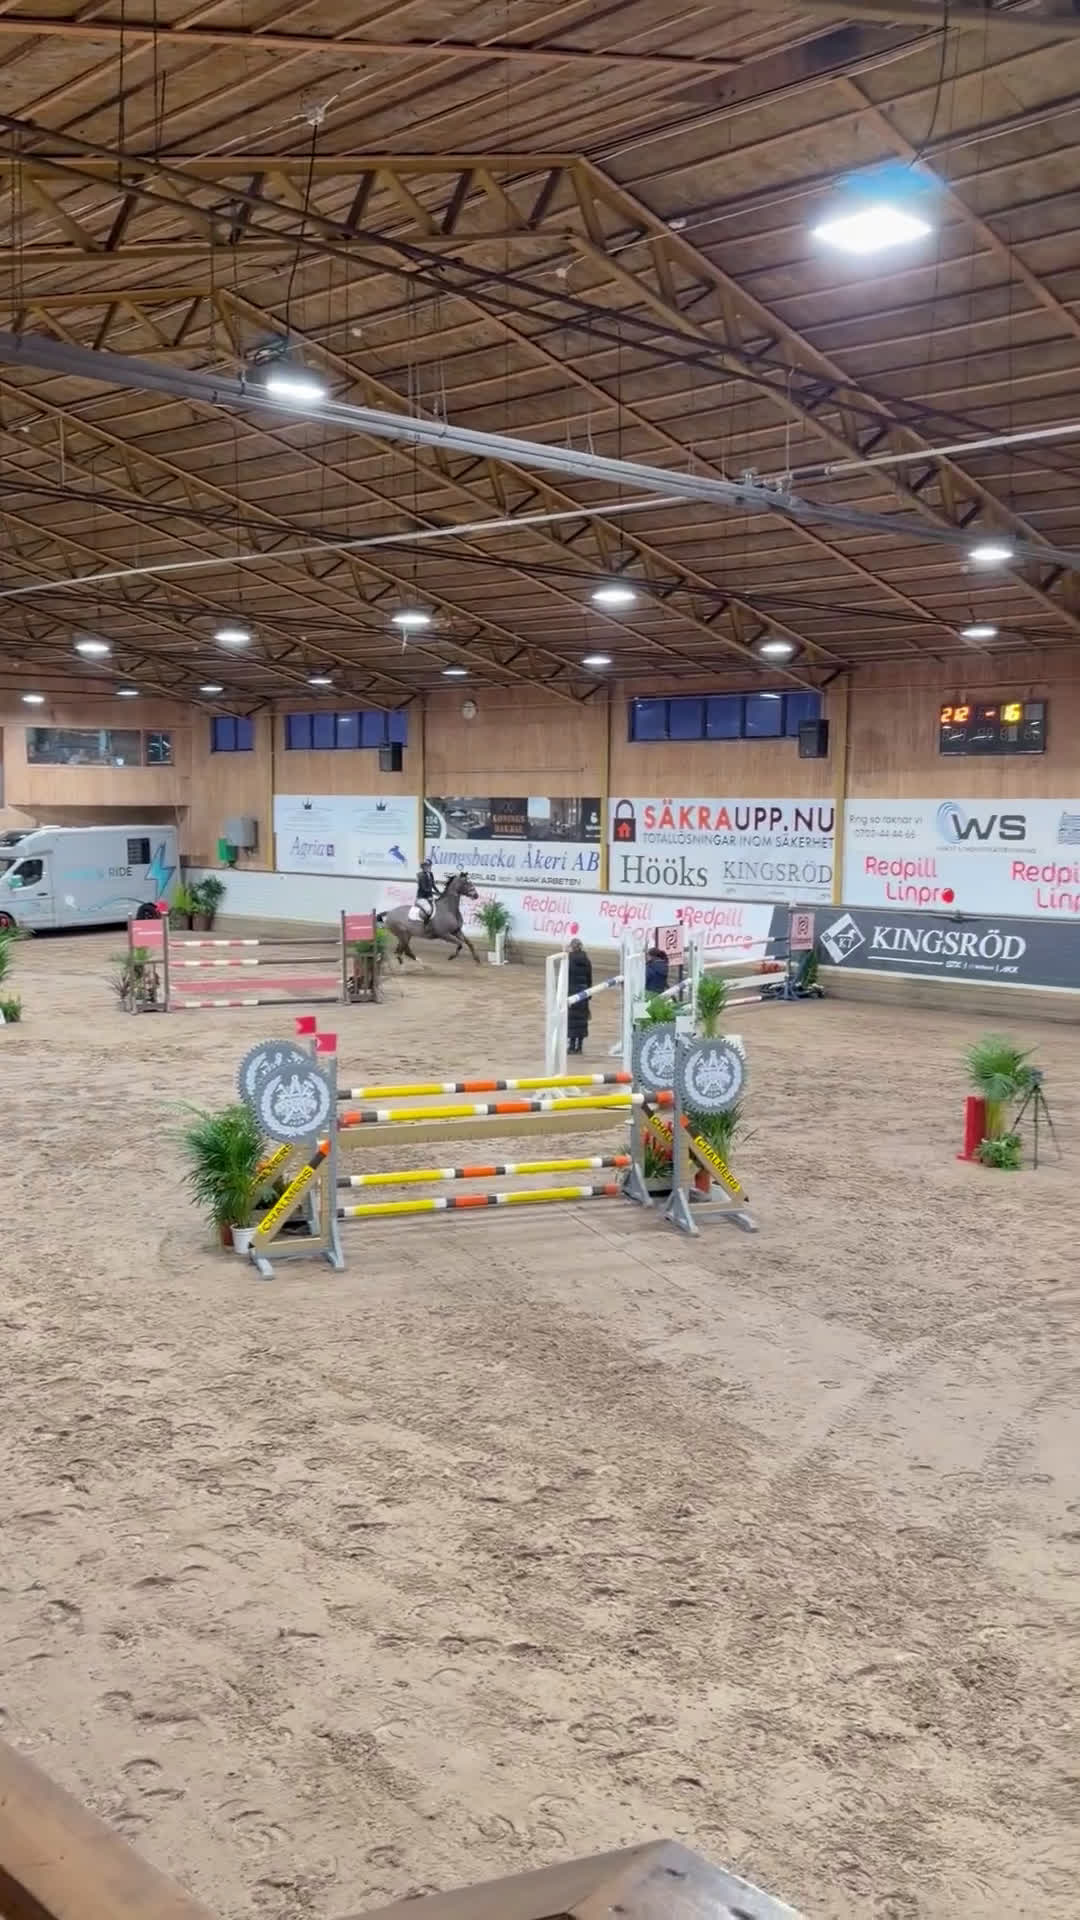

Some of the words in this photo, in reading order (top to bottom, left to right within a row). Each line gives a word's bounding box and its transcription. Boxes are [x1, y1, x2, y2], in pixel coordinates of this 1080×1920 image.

[644, 798, 835, 832] SÄKRAUPP.NU
[951, 814, 1027, 841] WS
[643, 832, 736, 846] TOTALLÖSNINGAR
[739, 836, 773, 847] INOM
[776, 834, 834, 849] SÄKERHET
[428, 845, 516, 871] Kungsbacka
[521, 844, 568, 871] Åkeri
[572, 851, 600, 872] AB
[620, 855, 708, 887] Hööks
[865, 856, 938, 880] Redpill
[108, 866, 133, 877] RIDE
[723, 859, 833, 884] KINGSRÖD
[522, 895, 573, 915] Redpill
[598, 900, 654, 921] Redpill
[684, 906, 743, 926] Redpill
[869, 925, 1027, 961] KINGSRÖD
[695, 1136, 741, 1191] CHALMERS
[262, 1167, 313, 1232] CHALMERS
